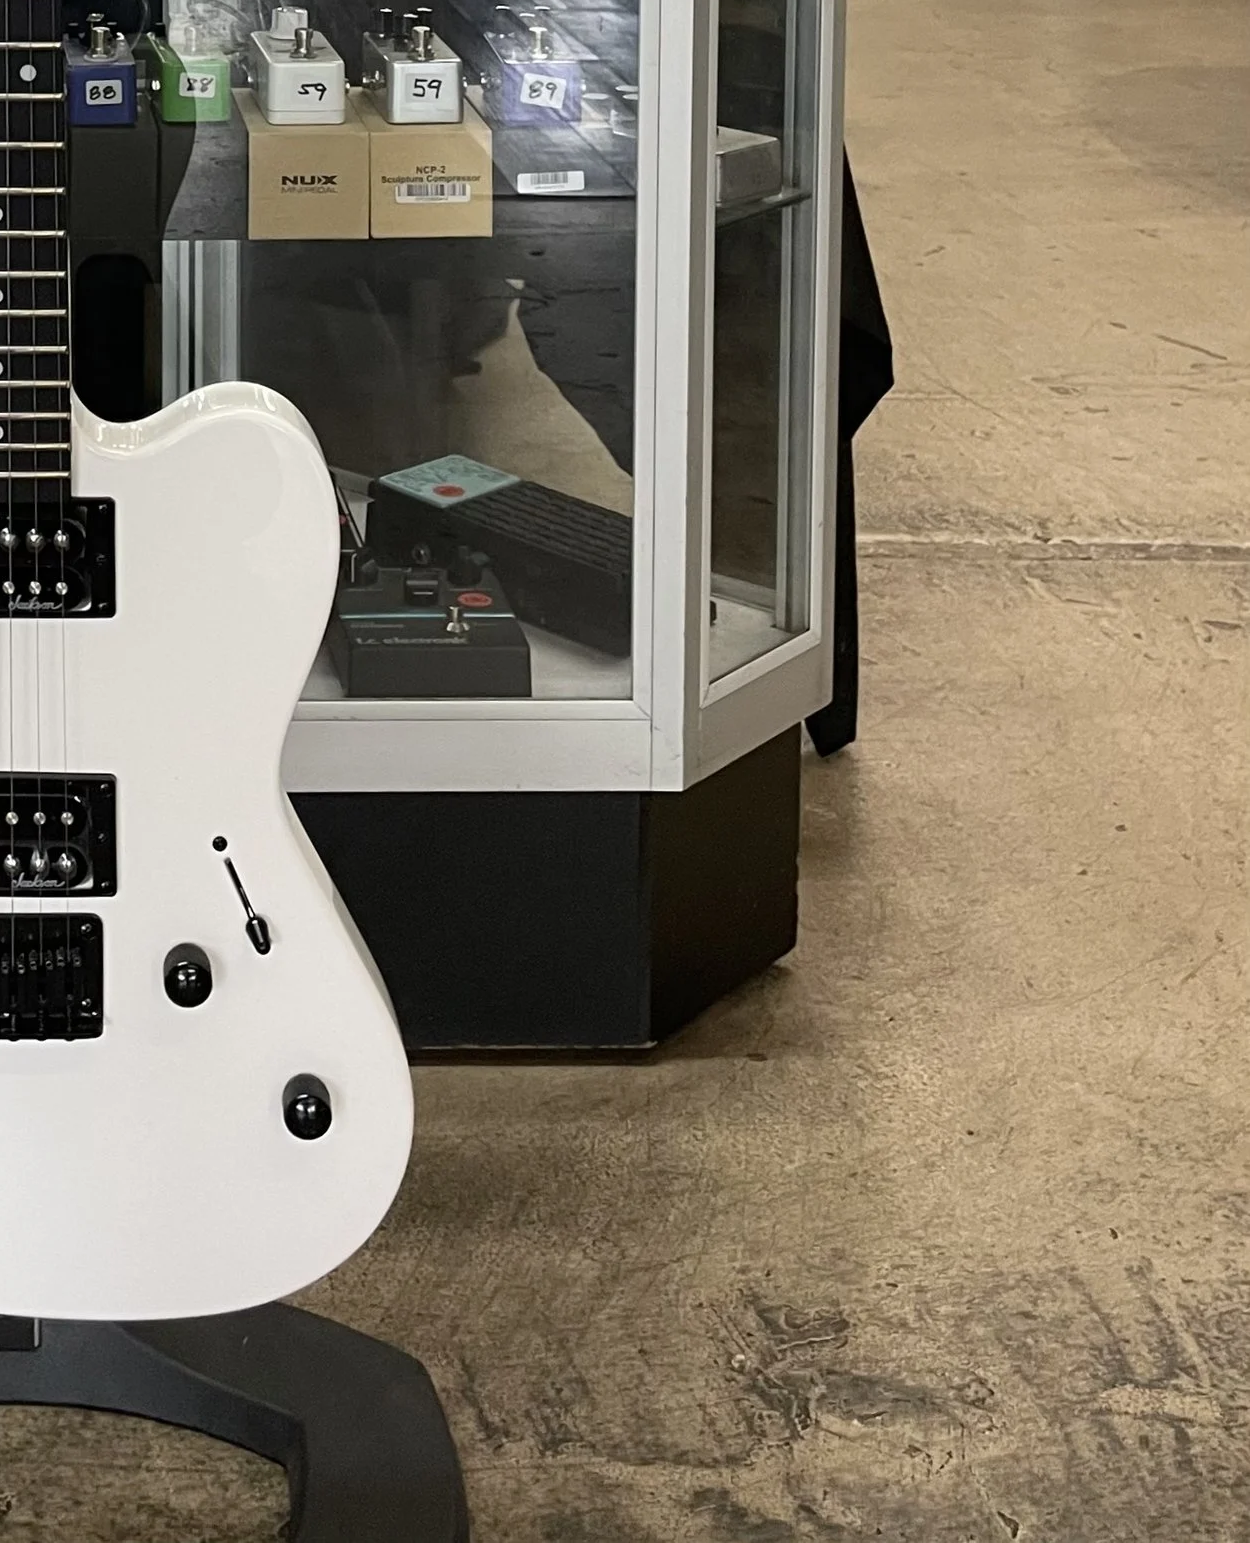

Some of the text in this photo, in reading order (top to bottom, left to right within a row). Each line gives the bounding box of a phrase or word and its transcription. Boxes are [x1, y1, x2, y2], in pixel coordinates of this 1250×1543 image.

[89, 85, 117, 101] 88
[298, 83, 328, 102] 59
[412, 78, 443, 100] 59
[528, 80, 558, 101] 89
[415, 165, 446, 175] NCP-2
[281, 175, 338, 186] NUX
[381, 174, 481, 184] Sculpture Compressor
